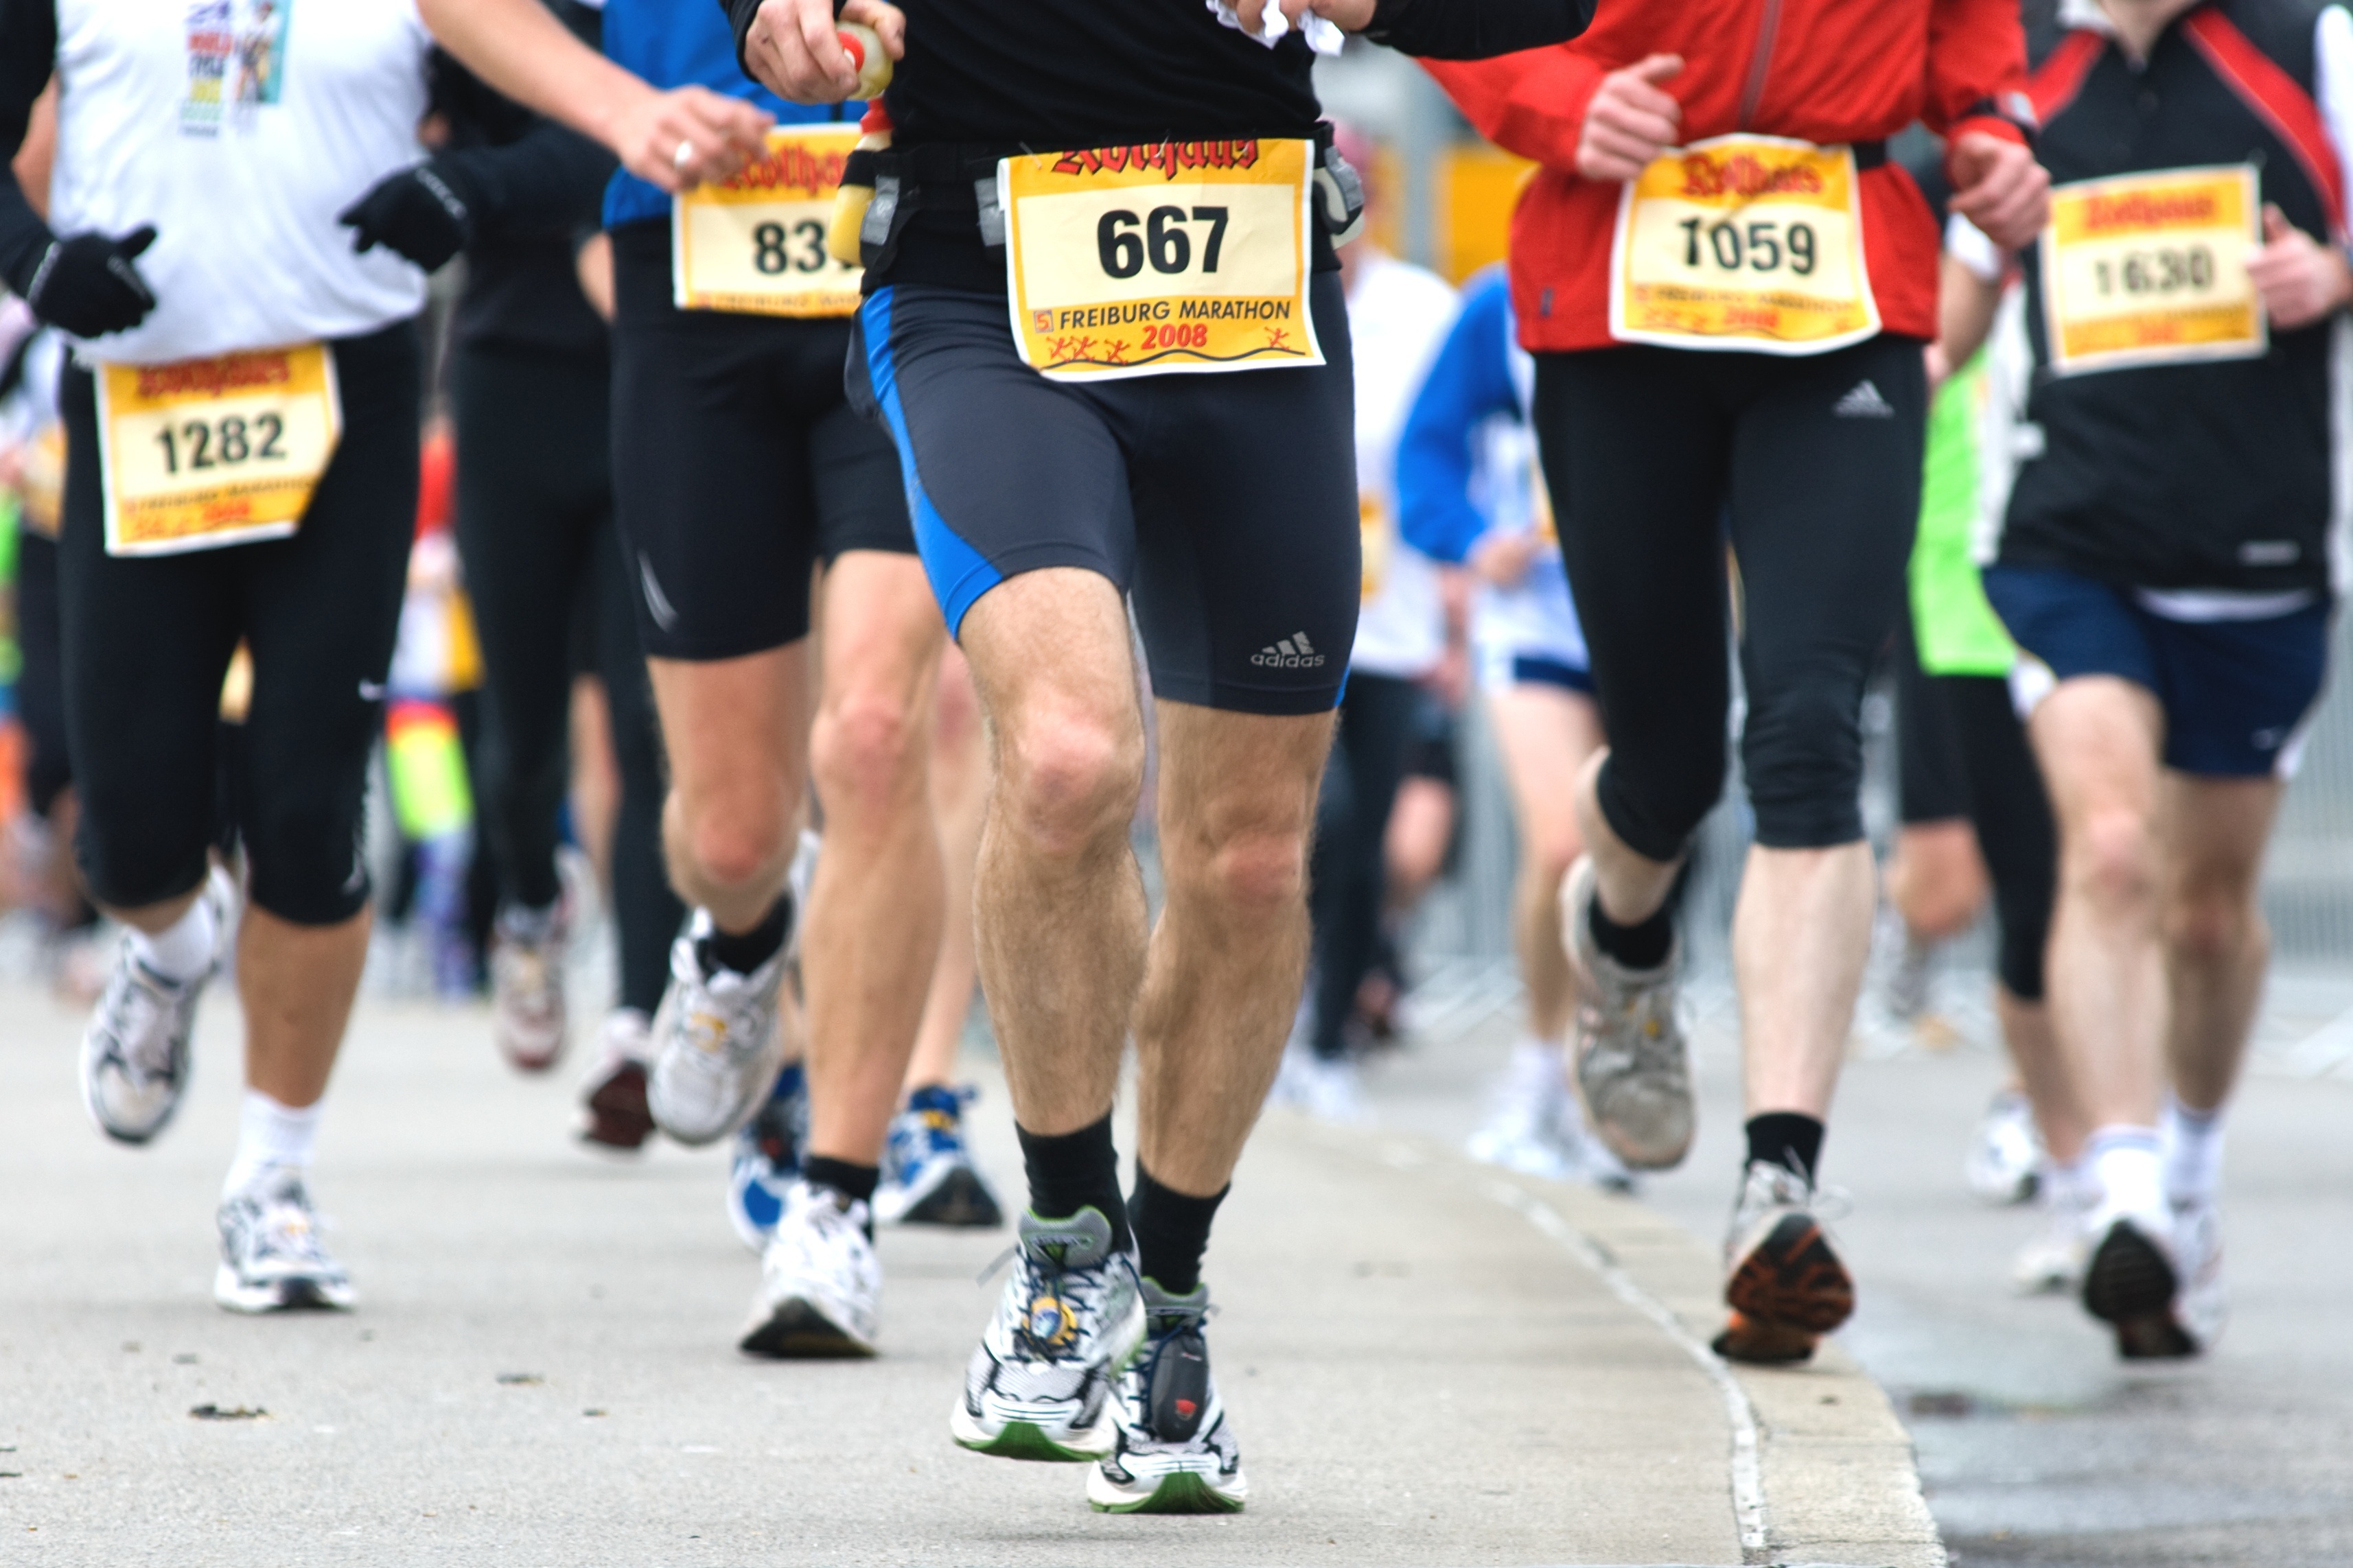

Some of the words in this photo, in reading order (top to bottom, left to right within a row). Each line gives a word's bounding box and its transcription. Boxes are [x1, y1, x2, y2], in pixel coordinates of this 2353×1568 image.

[753, 220, 854, 276] 83
[1097, 205, 1229, 280] 667
[1679, 216, 1816, 277] 1059
[2095, 245, 2214, 297] 1630
[1060, 301, 1170, 330] FREIBURG
[1179, 300, 1290, 320] MARATHON
[1141, 323, 1208, 350] 2008
[154, 412, 286, 475] 1282
[1250, 653, 1325, 668] adidas
